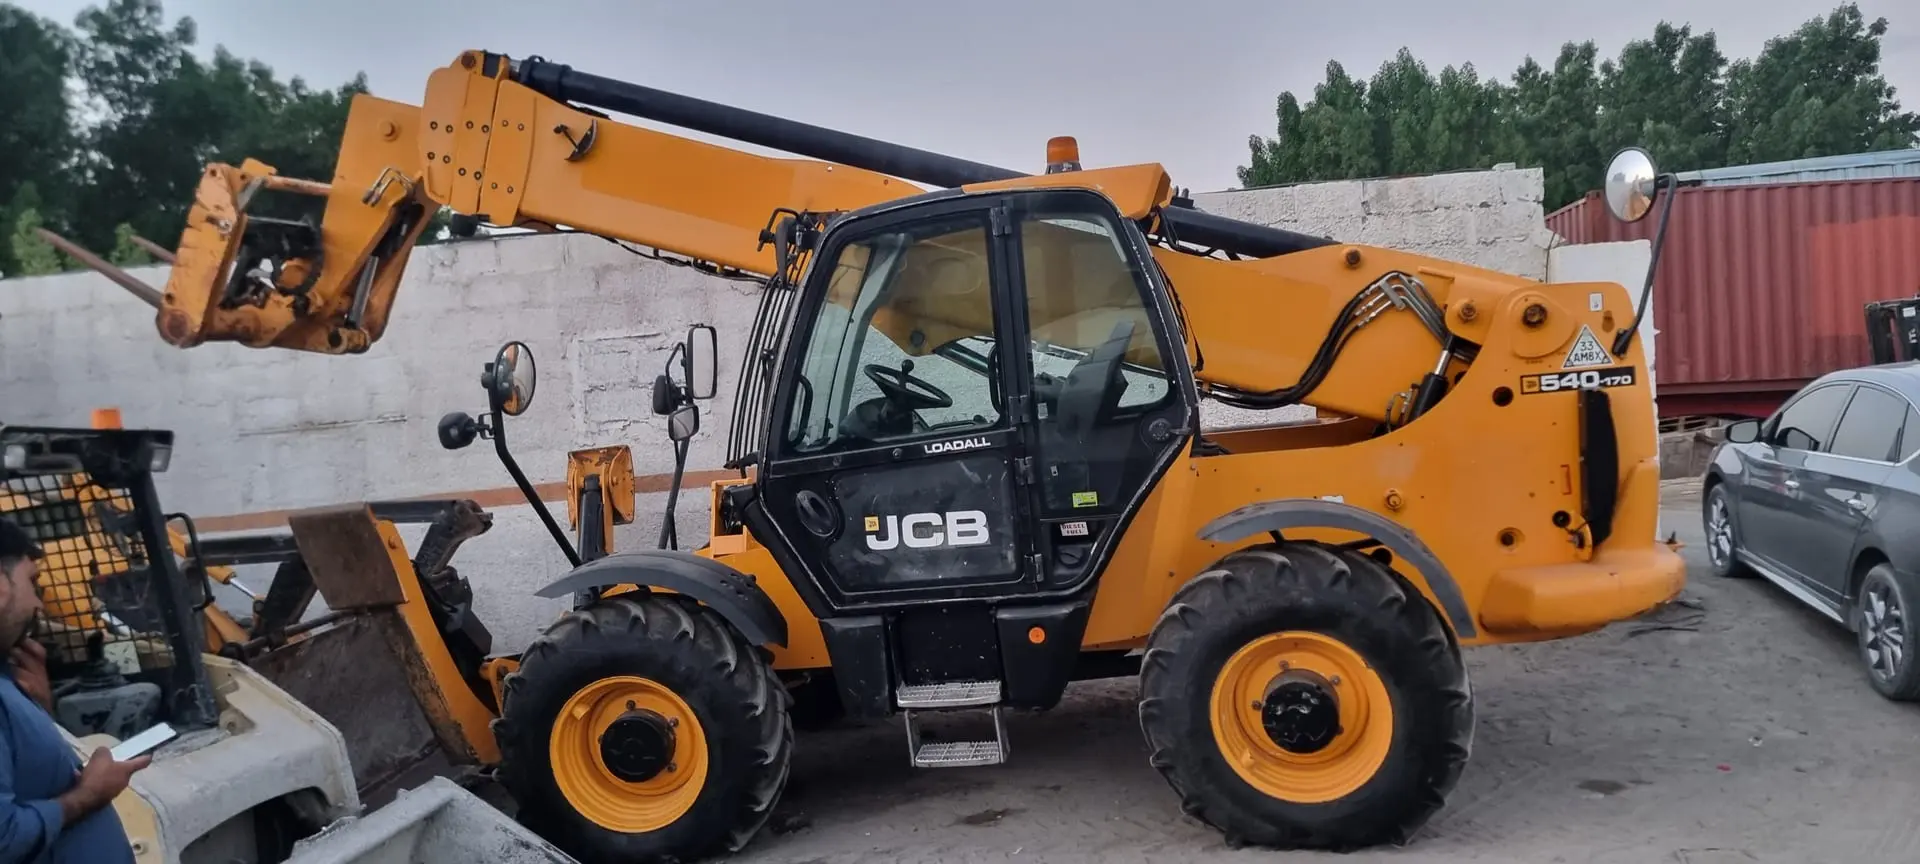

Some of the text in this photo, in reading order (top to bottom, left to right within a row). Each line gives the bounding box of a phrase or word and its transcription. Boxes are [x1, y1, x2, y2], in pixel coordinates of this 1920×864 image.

[1541, 371, 1632, 391] 540-170
[924, 437, 991, 454] LOADALL
[865, 510, 990, 550] JCB
